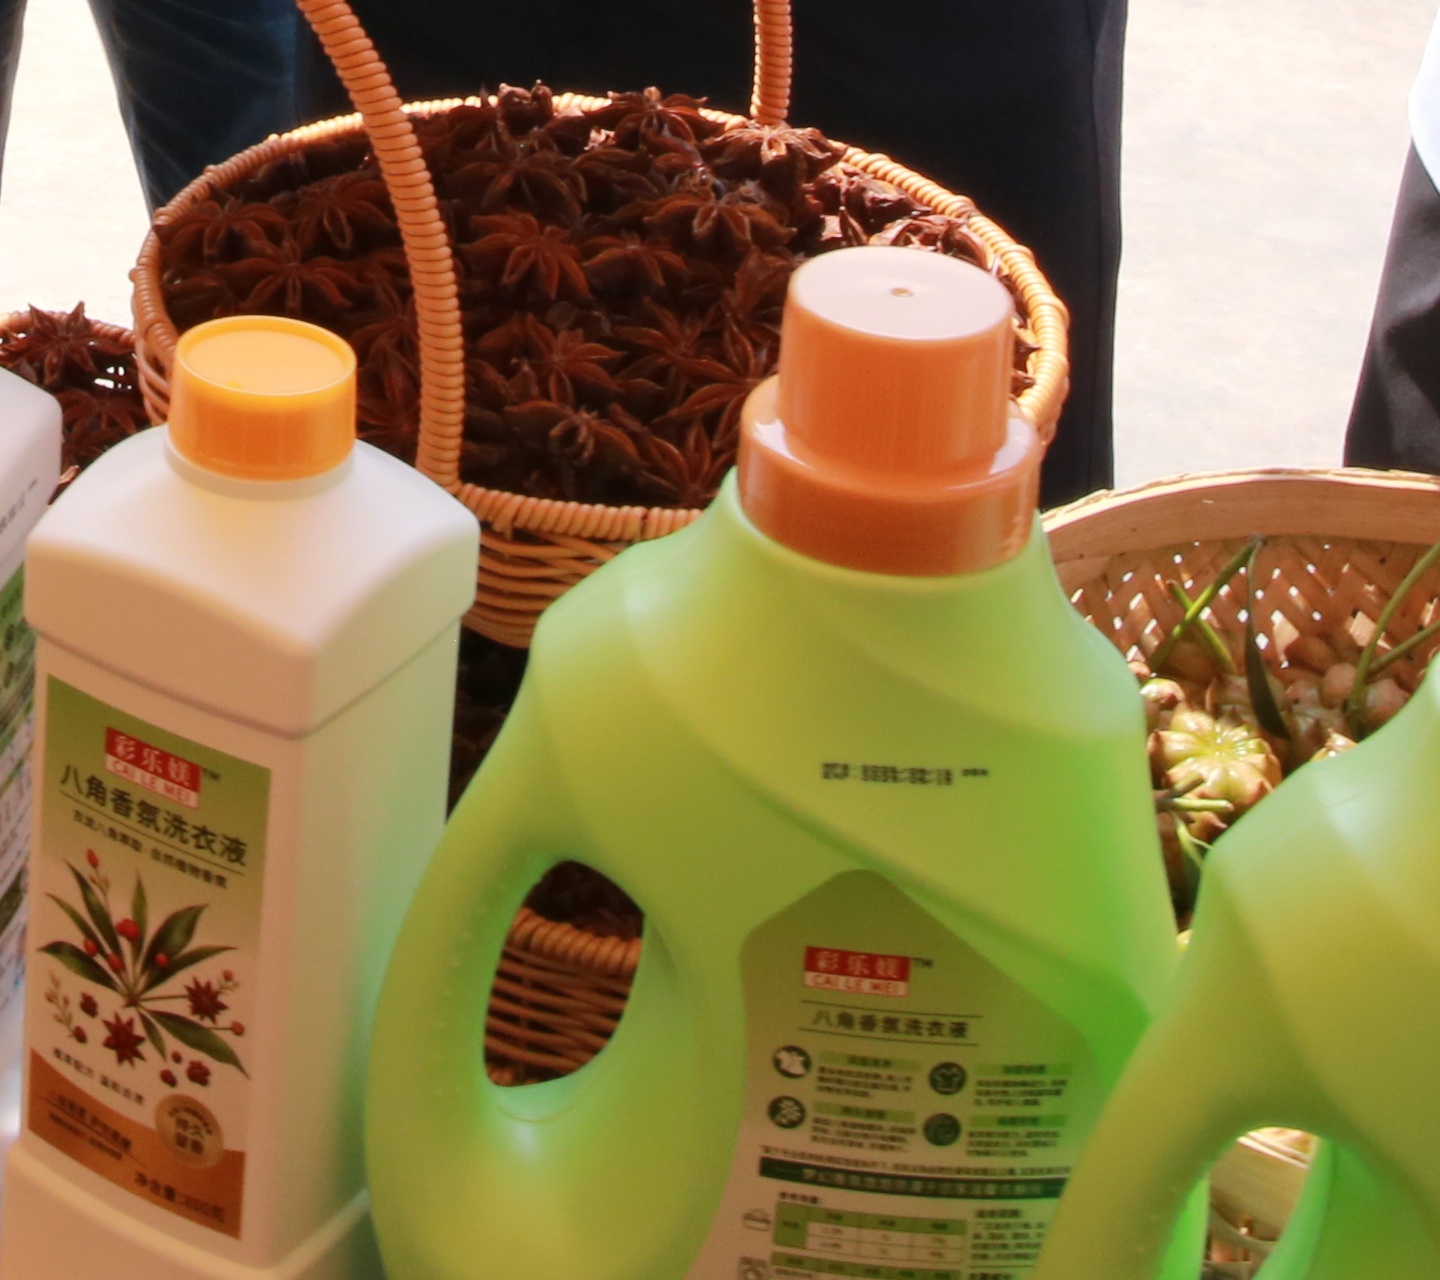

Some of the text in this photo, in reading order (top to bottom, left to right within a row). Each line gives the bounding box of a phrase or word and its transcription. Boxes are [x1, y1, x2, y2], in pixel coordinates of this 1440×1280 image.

[61, 764, 248, 867] 八角香氛洗衣液
[813, 1009, 970, 1039] 八角香氛洗衣液
